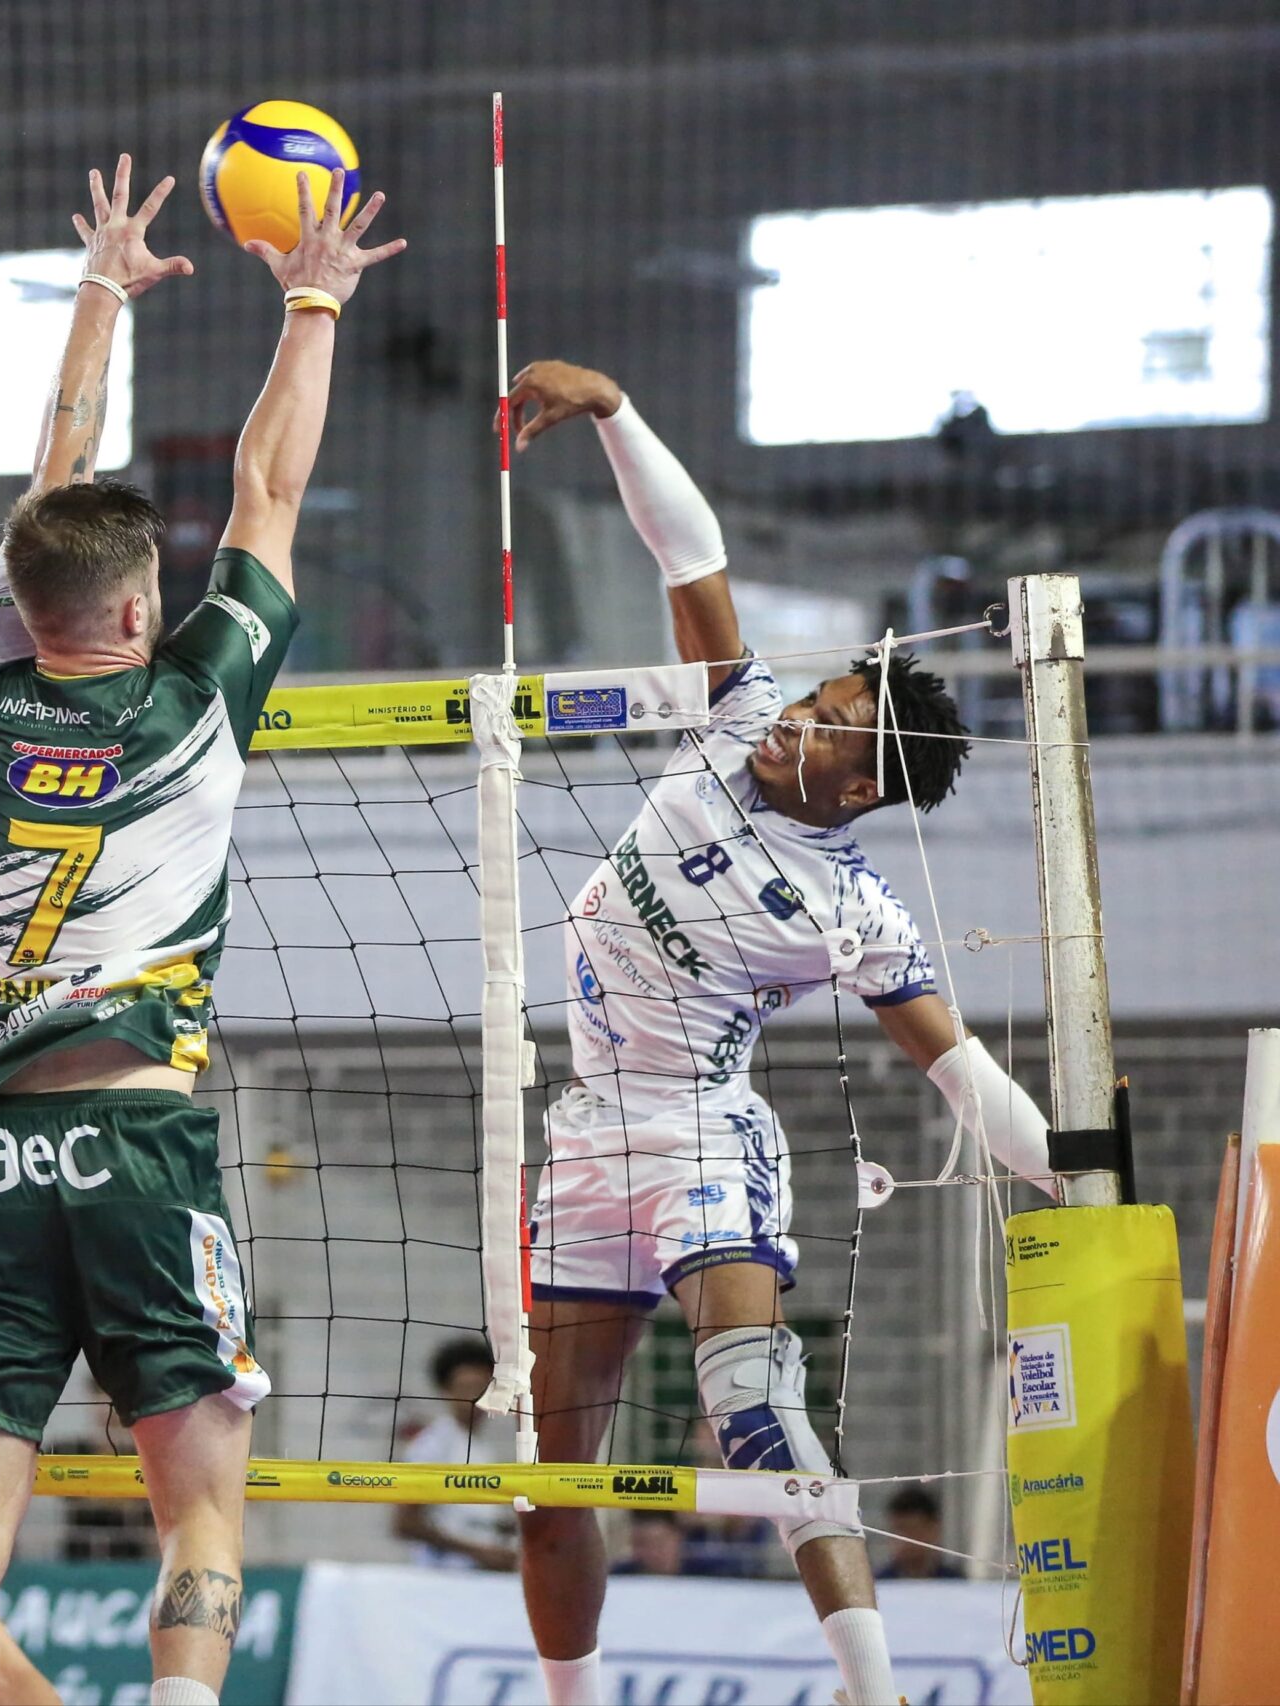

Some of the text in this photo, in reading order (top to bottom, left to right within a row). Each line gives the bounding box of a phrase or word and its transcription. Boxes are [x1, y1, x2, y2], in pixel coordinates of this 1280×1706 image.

[13, 742, 122, 760] SUPERMERCADOS
[22, 763, 108, 799] BH
[678, 842, 733, 887] 8
[8, 818, 103, 967] 7
[617, 830, 713, 982] BERNECK
[608, 943, 656, 997] VICENTE
[63, 987, 111, 1000] ATEUS
[1045, 1352, 1055, 1360] de
[1021, 1368, 1054, 1381] Voleibol
[1022, 1380, 1057, 1393] Escolar
[445, 1474, 501, 1490] rumo
[612, 1476, 678, 1494] BRASIL
[1023, 1473, 1084, 1492] Araucária
[1025, 1627, 1097, 1664] SMED
